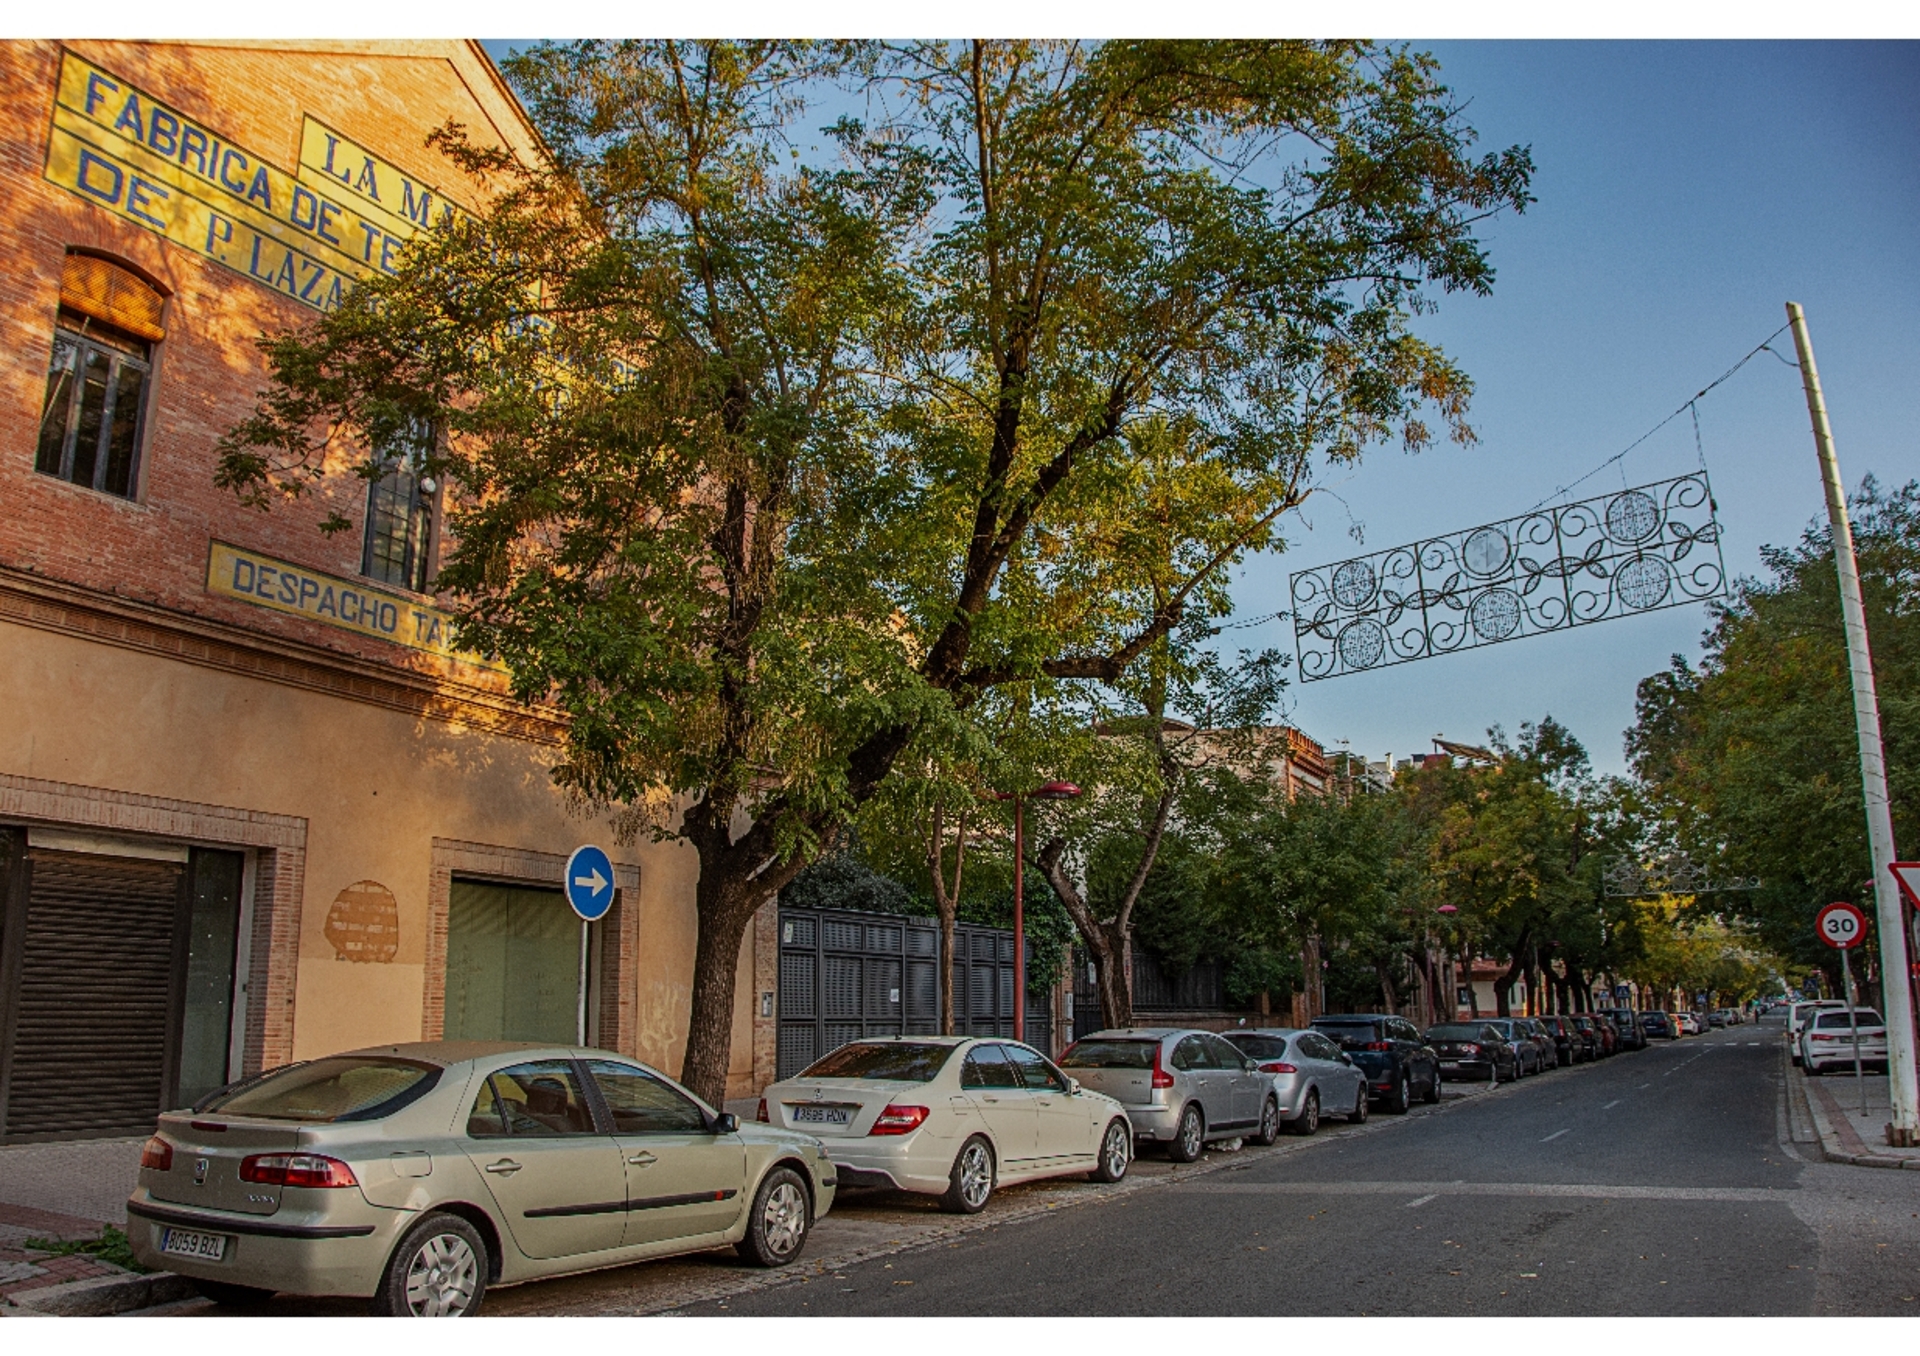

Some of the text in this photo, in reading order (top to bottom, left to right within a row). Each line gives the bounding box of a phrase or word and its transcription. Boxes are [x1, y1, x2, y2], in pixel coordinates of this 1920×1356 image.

[84, 71, 404, 276] FABRICA DE TE
[321, 132, 381, 203] LA
[76, 148, 345, 313] DE P. LAZA
[233, 557, 398, 633] DESPACHO
[1827, 918, 1854, 934] 30
[168, 1231, 220, 1257] 8059 BZL
